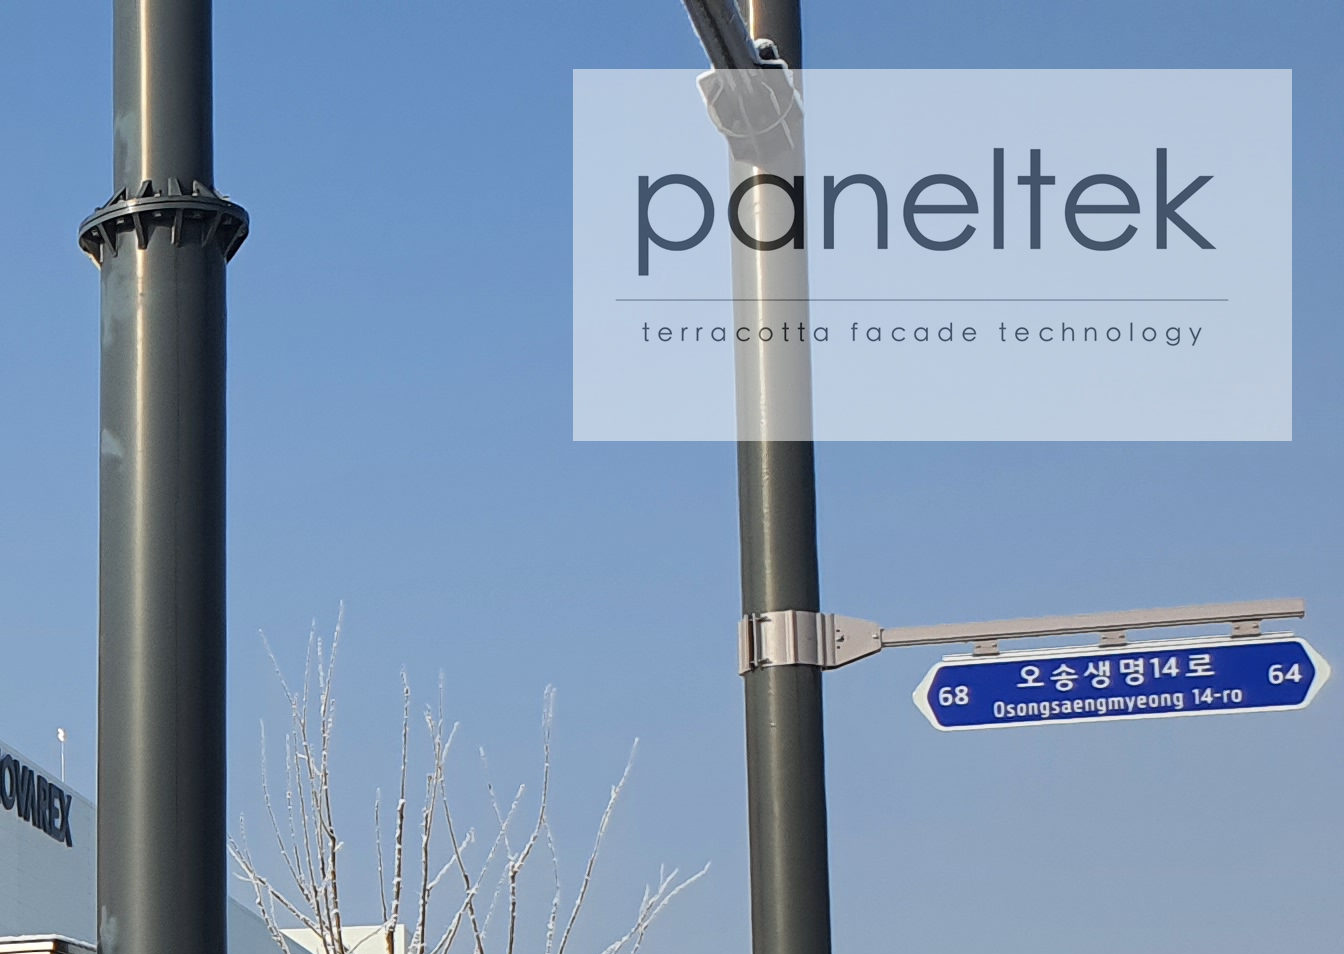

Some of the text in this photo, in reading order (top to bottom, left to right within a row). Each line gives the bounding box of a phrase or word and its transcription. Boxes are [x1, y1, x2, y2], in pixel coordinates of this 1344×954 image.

[1016, 653, 1215, 692] 오송생명14로
[1268, 663, 1302, 685] 64
[938, 687, 969, 706] 68
[993, 688, 1242, 718] Osongsaengmyeong 14-ro
